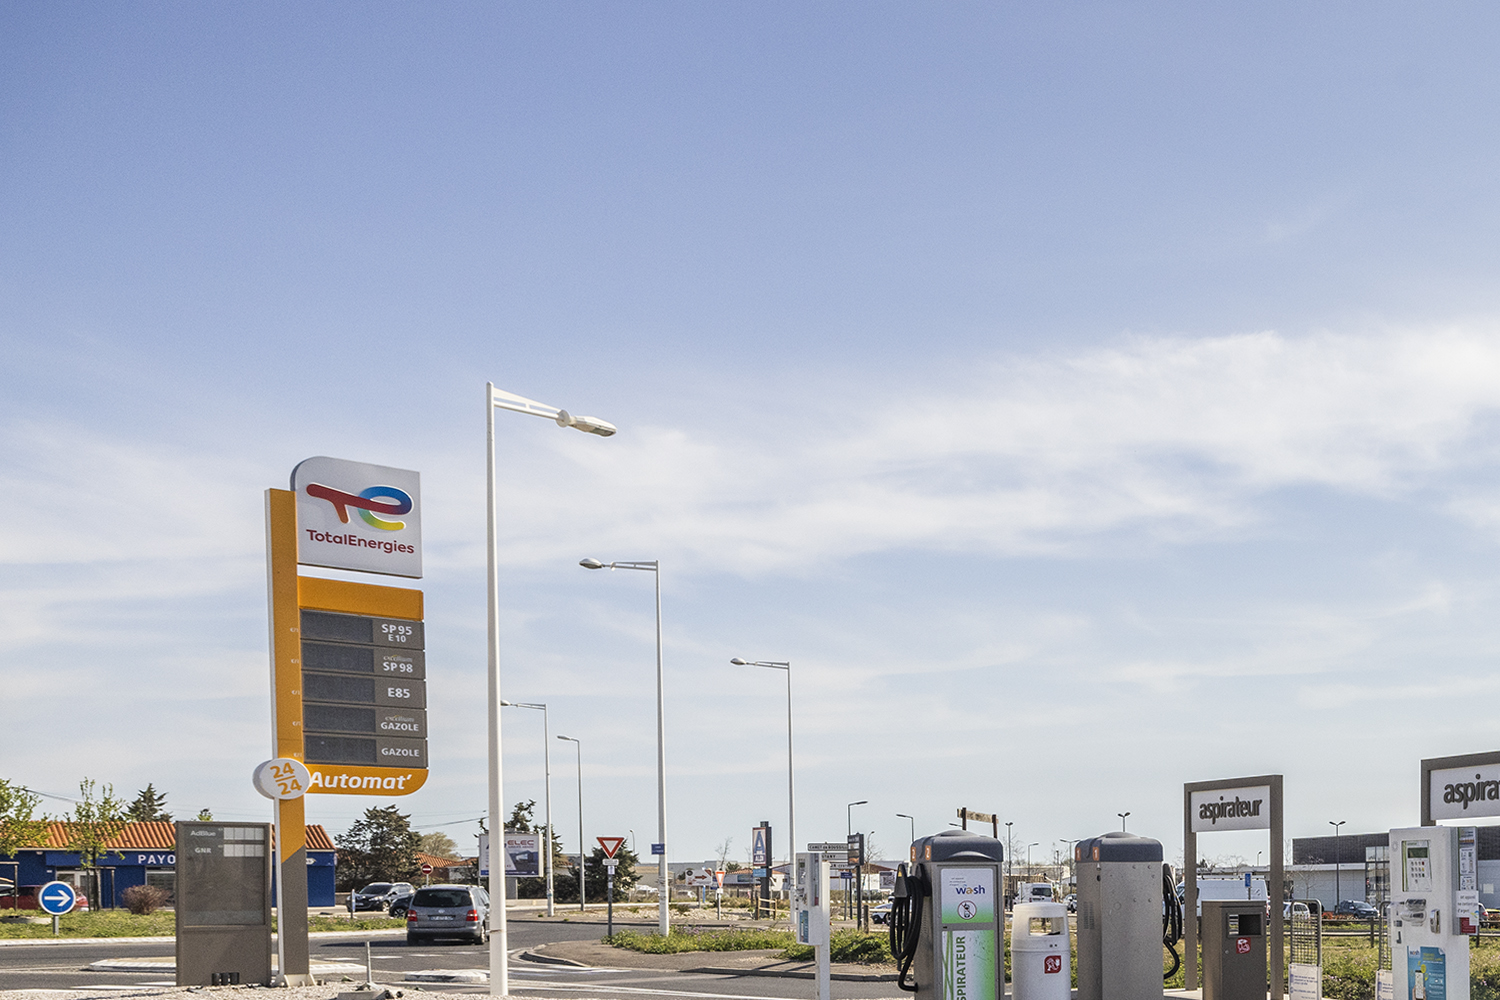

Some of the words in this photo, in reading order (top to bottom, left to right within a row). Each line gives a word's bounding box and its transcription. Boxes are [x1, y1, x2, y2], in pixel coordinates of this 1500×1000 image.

[306, 529, 415, 554] TotalEnergies
[381, 623, 396, 634] SP
[397, 625, 413, 636] 95
[395, 634, 407, 643] 10
[382, 661, 398, 671] SP
[399, 663, 413, 673] 98
[387, 687, 411, 699] E85
[380, 721, 419, 732] GAZOLE
[381, 747, 420, 757] GAZOLE
[270, 762, 295, 779] 24
[277, 780, 302, 796] 24
[1199, 795, 1263, 825] aspirateur
[956, 884, 986, 895] wash
